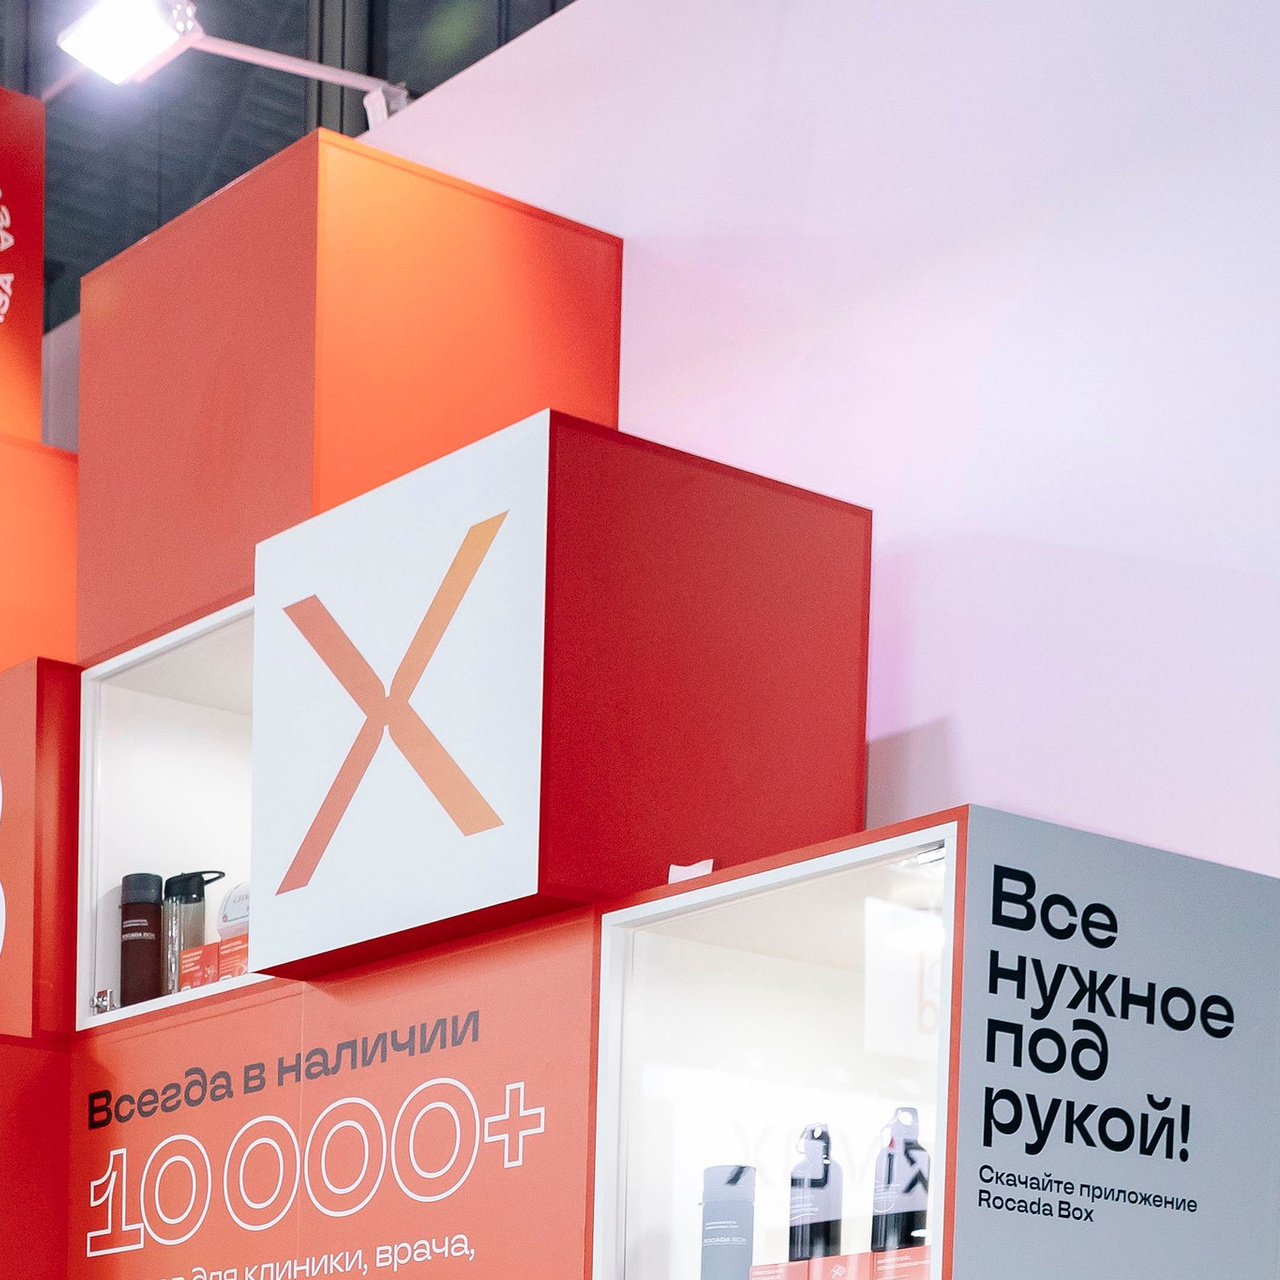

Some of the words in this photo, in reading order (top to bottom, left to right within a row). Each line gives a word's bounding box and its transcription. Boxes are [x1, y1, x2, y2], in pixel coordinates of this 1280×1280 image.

[275, 510, 510, 896] X
[991, 863, 1119, 949] Все
[987, 949, 1236, 1040] нужное
[87, 1067, 233, 1130] Всегда
[242, 1061, 268, 1093] в
[276, 1010, 480, 1083] наличии
[985, 1017, 1110, 1082] под
[982, 1085, 1192, 1163] рукой!
[977, 1189, 1054, 1218] Rocada
[1057, 1200, 1095, 1223] Box
[978, 1164, 1075, 1195] Скачайте
[1078, 1182, 1198, 1214] приложение
[374, 1231, 477, 1270] врача,
